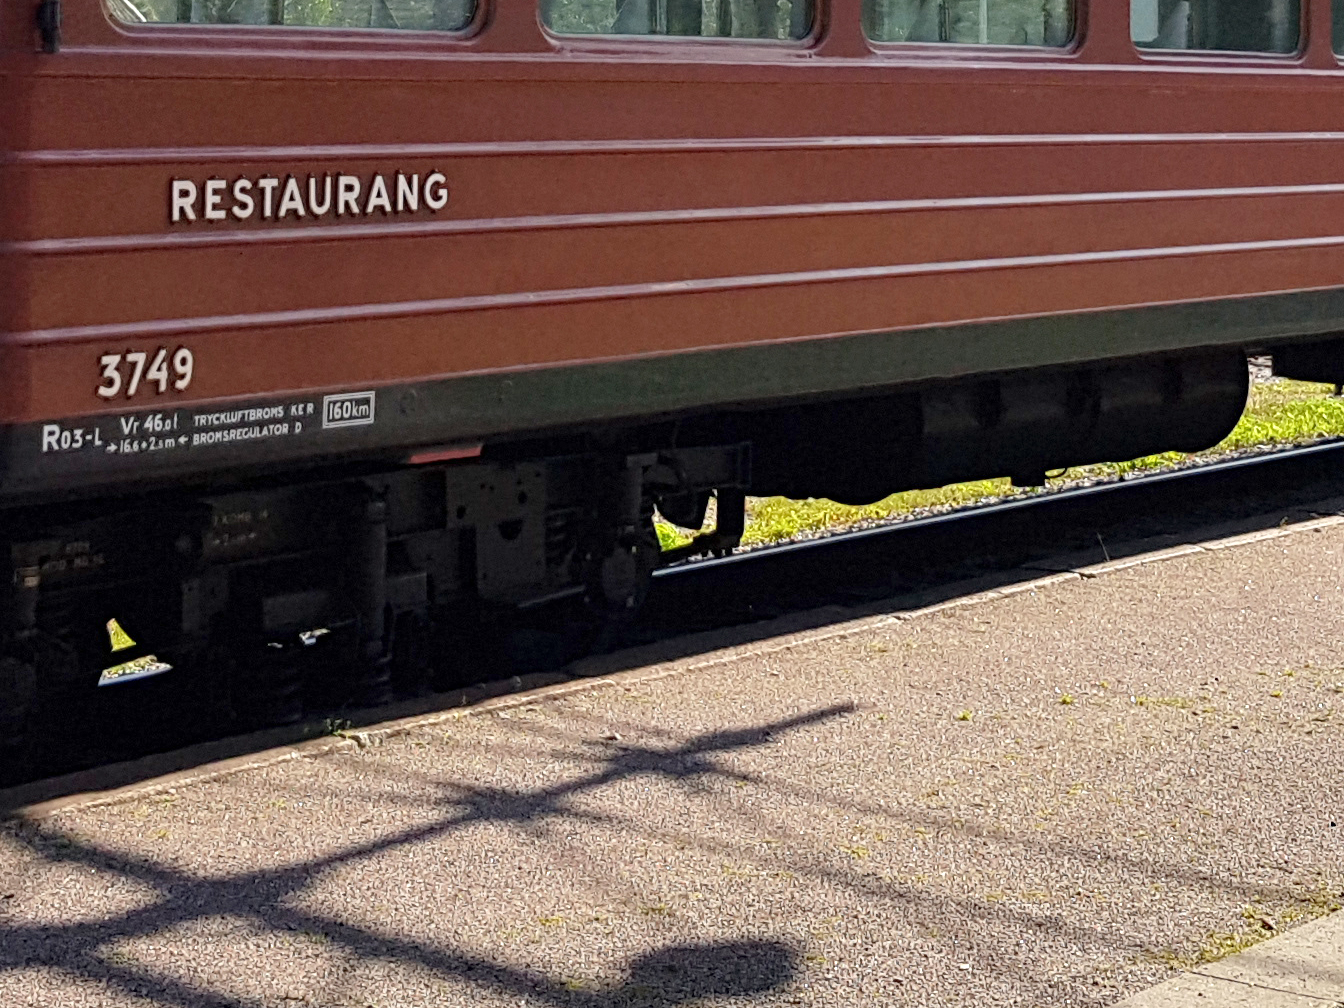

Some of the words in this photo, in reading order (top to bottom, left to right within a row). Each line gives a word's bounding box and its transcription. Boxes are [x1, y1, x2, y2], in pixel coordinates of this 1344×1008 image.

[171, 173, 448, 222] RESTAURANG
[97, 348, 194, 397] 3749
[120, 416, 140, 435] Vr
[194, 405, 284, 426] TRYCKLUFTBROMS
[192, 423, 289, 445] BROMSREGULATOR
[294, 421, 302, 434] D
